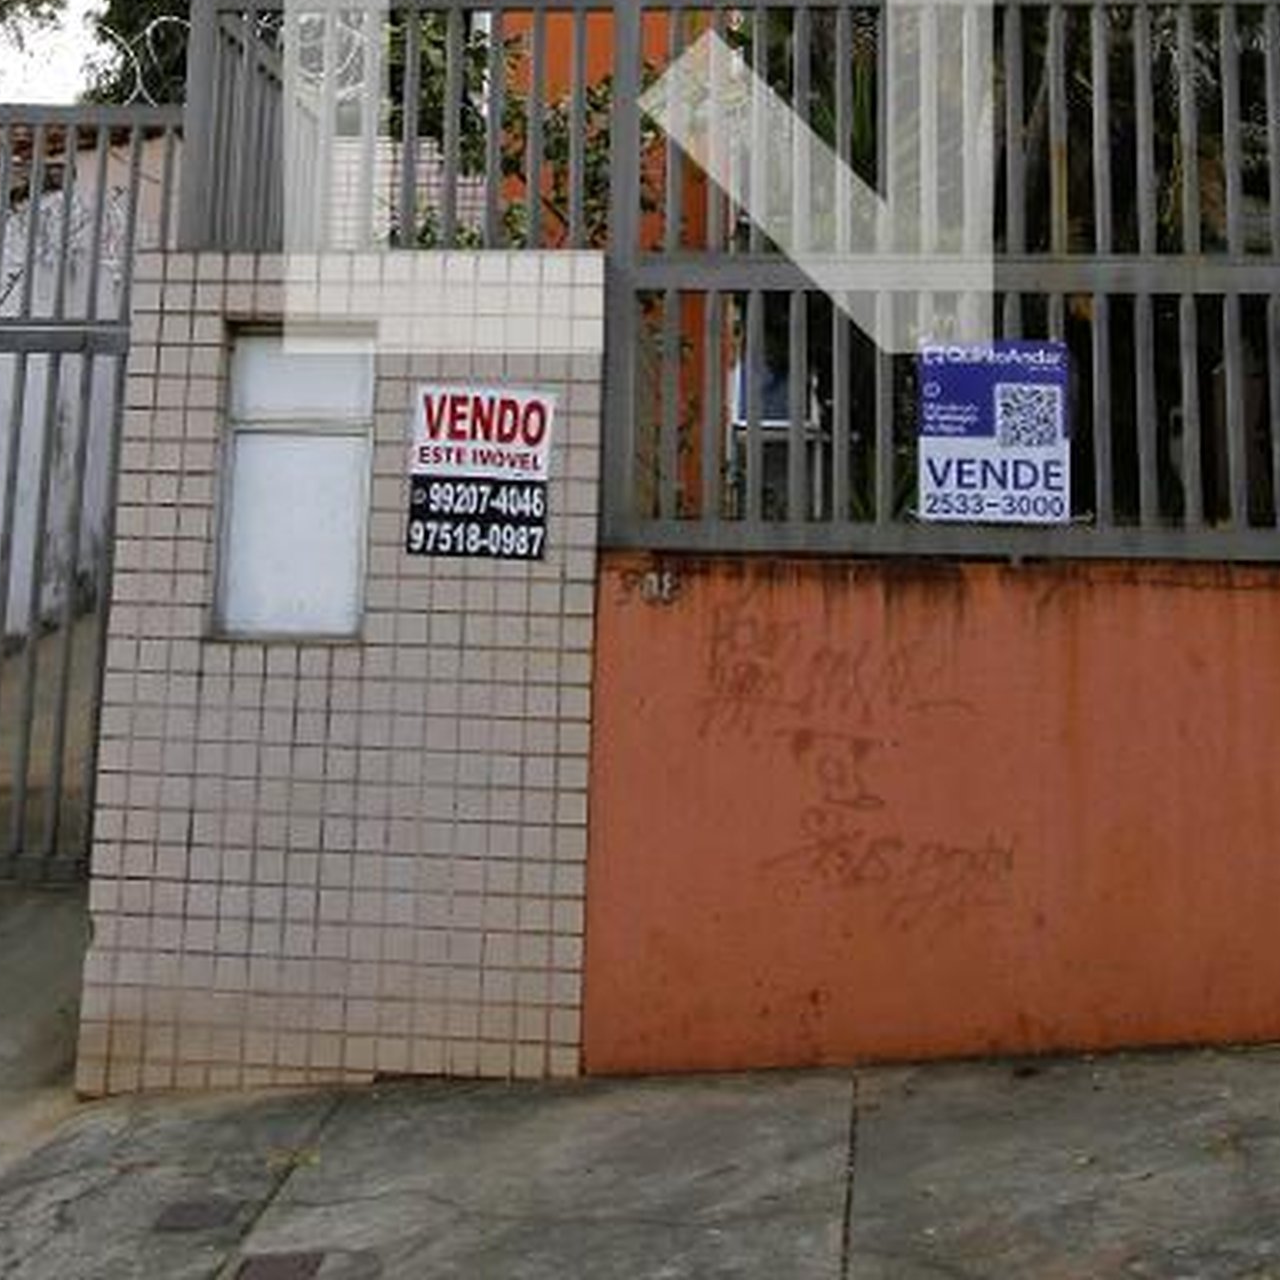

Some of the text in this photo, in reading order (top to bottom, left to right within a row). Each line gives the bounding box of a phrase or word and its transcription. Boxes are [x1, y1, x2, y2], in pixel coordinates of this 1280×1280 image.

[424, 395, 546, 446] VENDO
[419, 446, 467, 465] ESTE
[926, 458, 1064, 491] VENDE
[429, 482, 544, 518] 99207-4046
[925, 493, 1064, 516] 2533-3000
